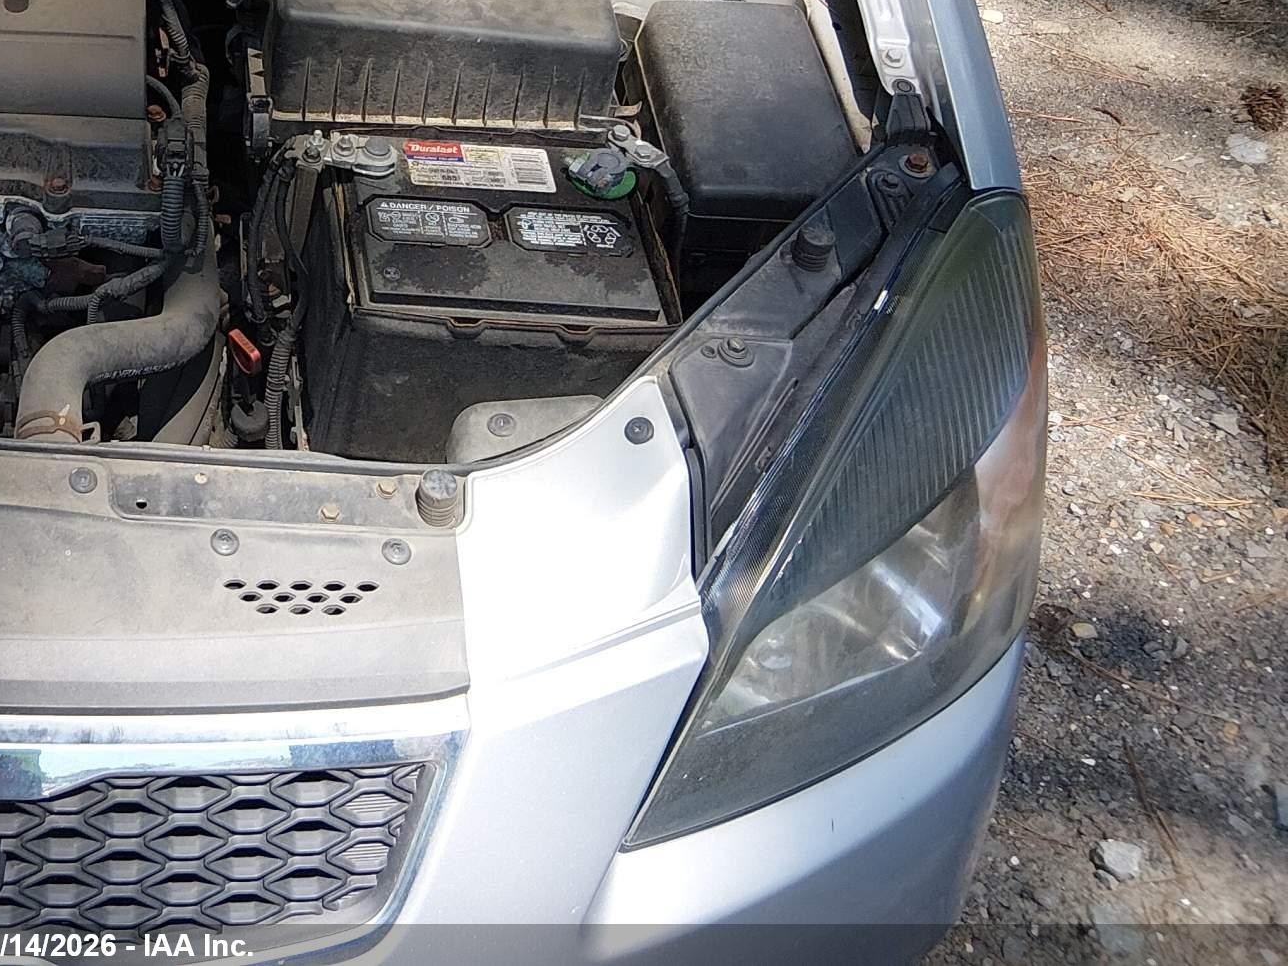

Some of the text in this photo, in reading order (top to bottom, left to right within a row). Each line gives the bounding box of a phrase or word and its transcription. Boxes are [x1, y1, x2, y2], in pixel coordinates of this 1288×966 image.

[408, 143, 459, 154] Duralast
[389, 202, 427, 210] DANGER
[436, 205, 470, 213] POISON
